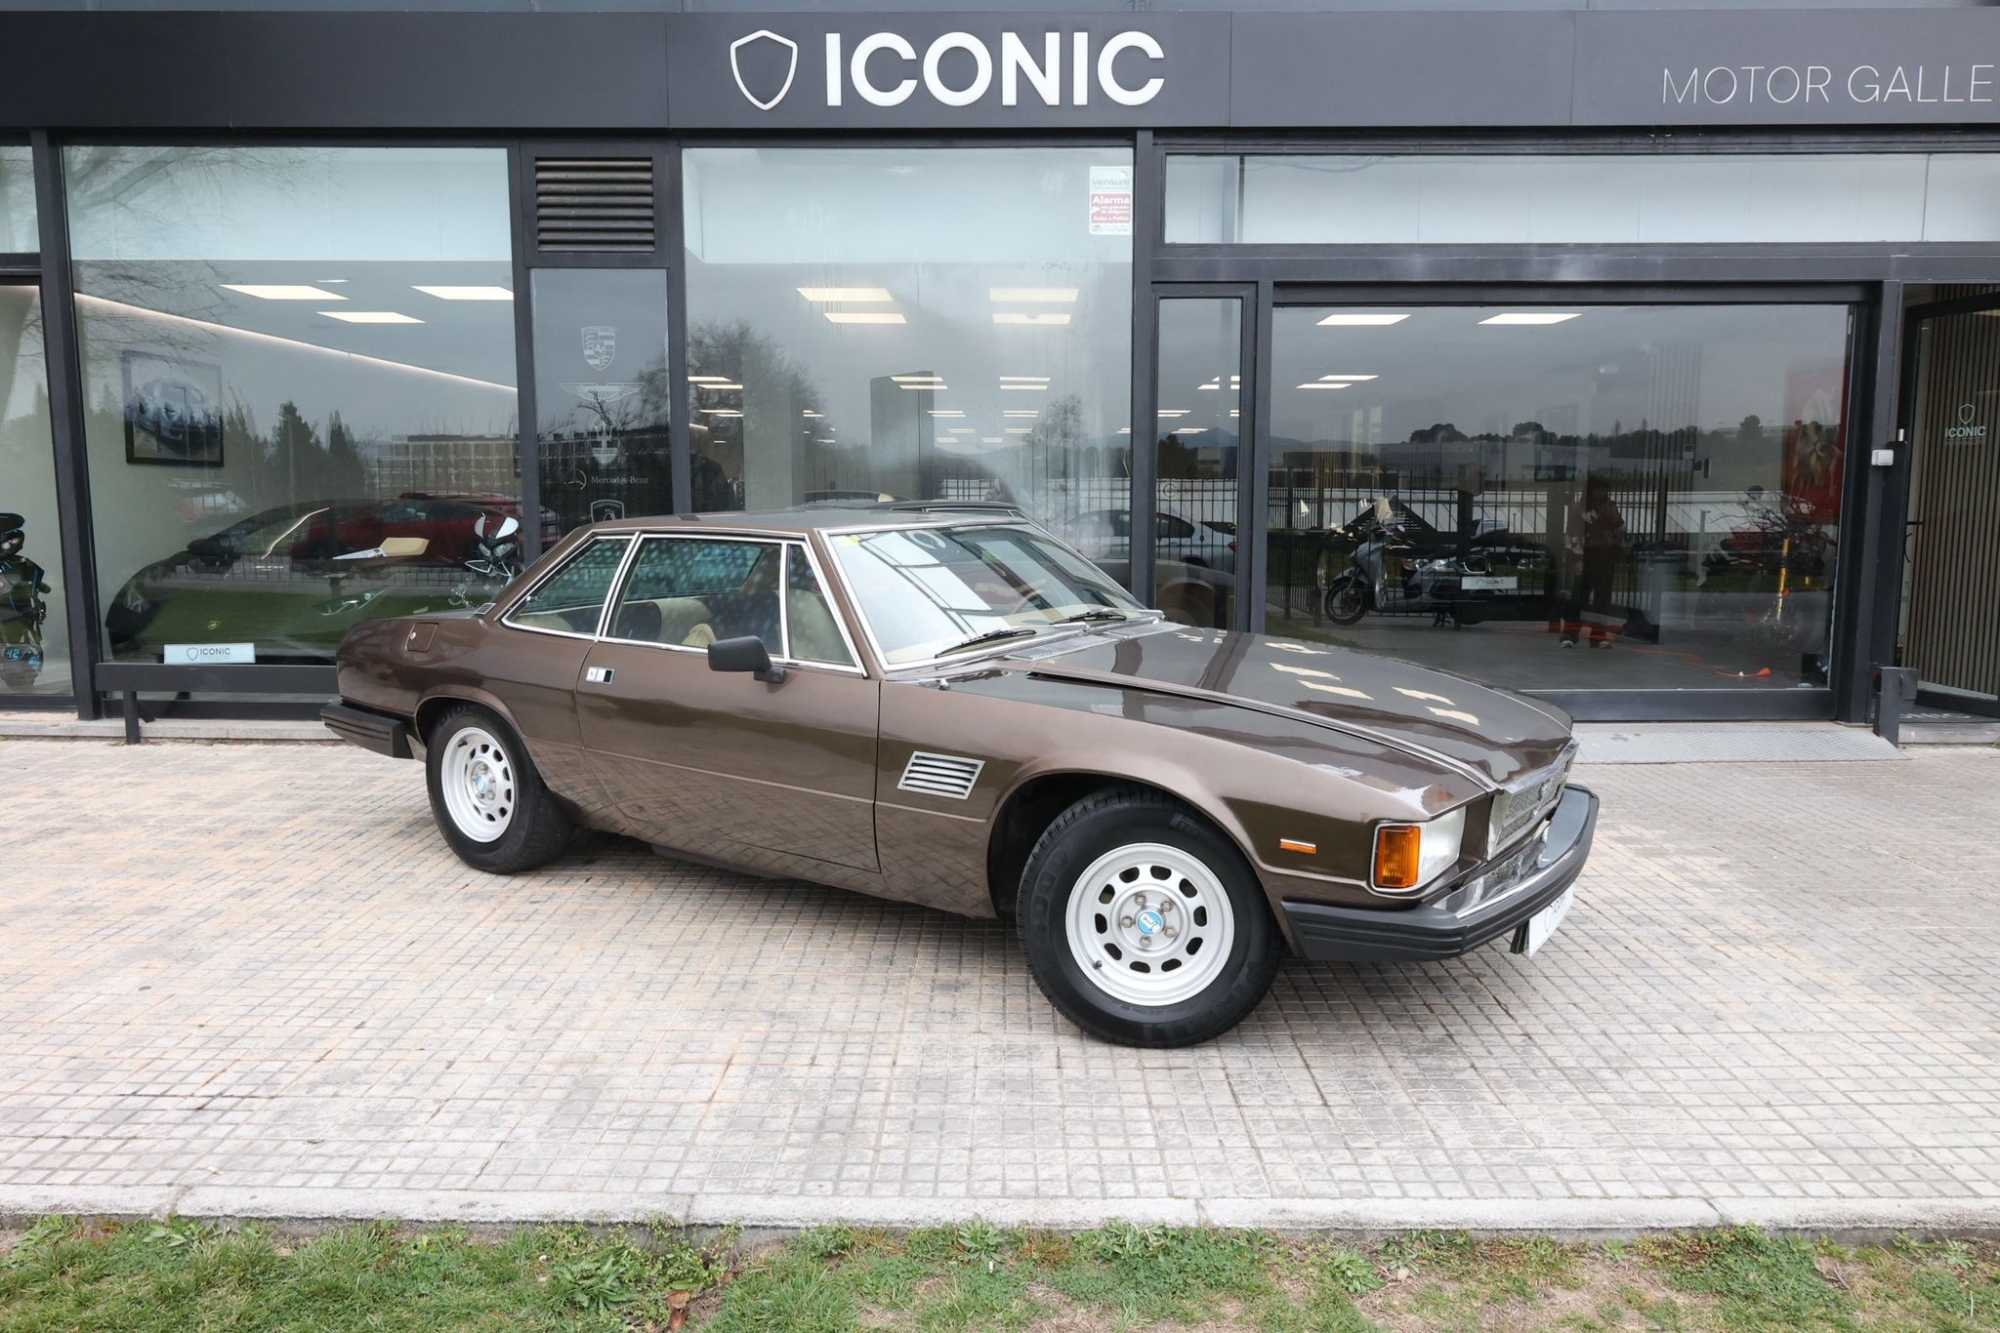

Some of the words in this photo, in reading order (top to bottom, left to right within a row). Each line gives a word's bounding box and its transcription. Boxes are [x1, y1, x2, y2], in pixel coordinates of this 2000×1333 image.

[825, 31, 1165, 107] ICONIC
[1662, 66, 1832, 104] MOTOR
[1847, 64, 2000, 102] GALLE
[1092, 178, 1130, 187] verisure
[1092, 195, 1130, 204] Alarma
[1945, 426, 1986, 438] ICONIC
[591, 475, 650, 485] Mercedes-Benz
[200, 647, 231, 656] ICONIC
